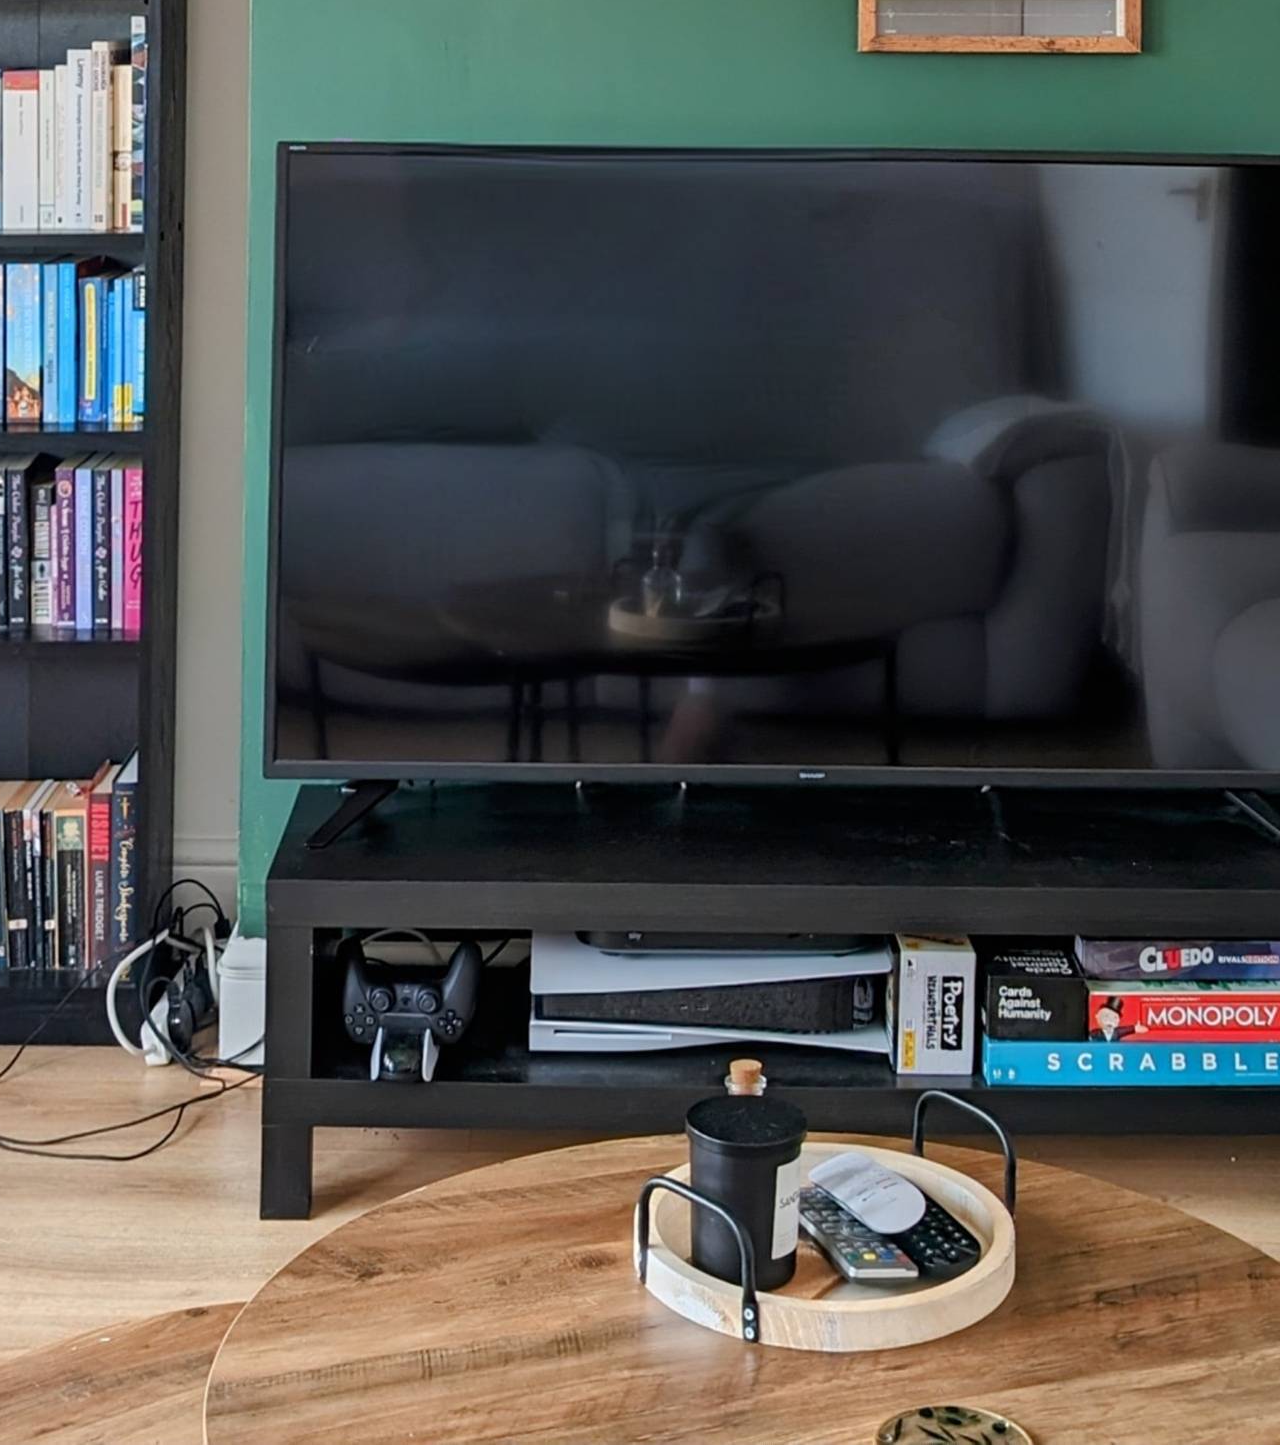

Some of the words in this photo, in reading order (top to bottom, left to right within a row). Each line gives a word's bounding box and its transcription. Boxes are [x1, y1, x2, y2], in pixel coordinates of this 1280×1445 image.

[75, 58, 85, 89] Limmy
[12, 474, 22, 491] The
[96, 475, 105, 490] The
[11, 516, 21, 543] Purple
[95, 516, 105, 543] Purple
[129, 500, 141, 589] THUG
[91, 803, 109, 862] KISMET
[95, 870, 104, 895] LUKE
[95, 898, 105, 941] TREDGET
[115, 880, 135, 943] Shakespeare
[1139, 946, 1214, 972] CLUEDO
[1218, 955, 1245, 964] RIVALS
[1245, 955, 1280, 964] EDITION
[998, 997, 1041, 1010] Against
[999, 986, 1032, 997] Cards
[925, 975, 938, 1050] NEANDERTHALS
[942, 980, 962, 1047] Poetry
[998, 1009, 1052, 1021] Humanity
[1147, 1006, 1278, 1027] MONOPOLY
[1047, 1052, 1279, 1071] SCRABBLE
